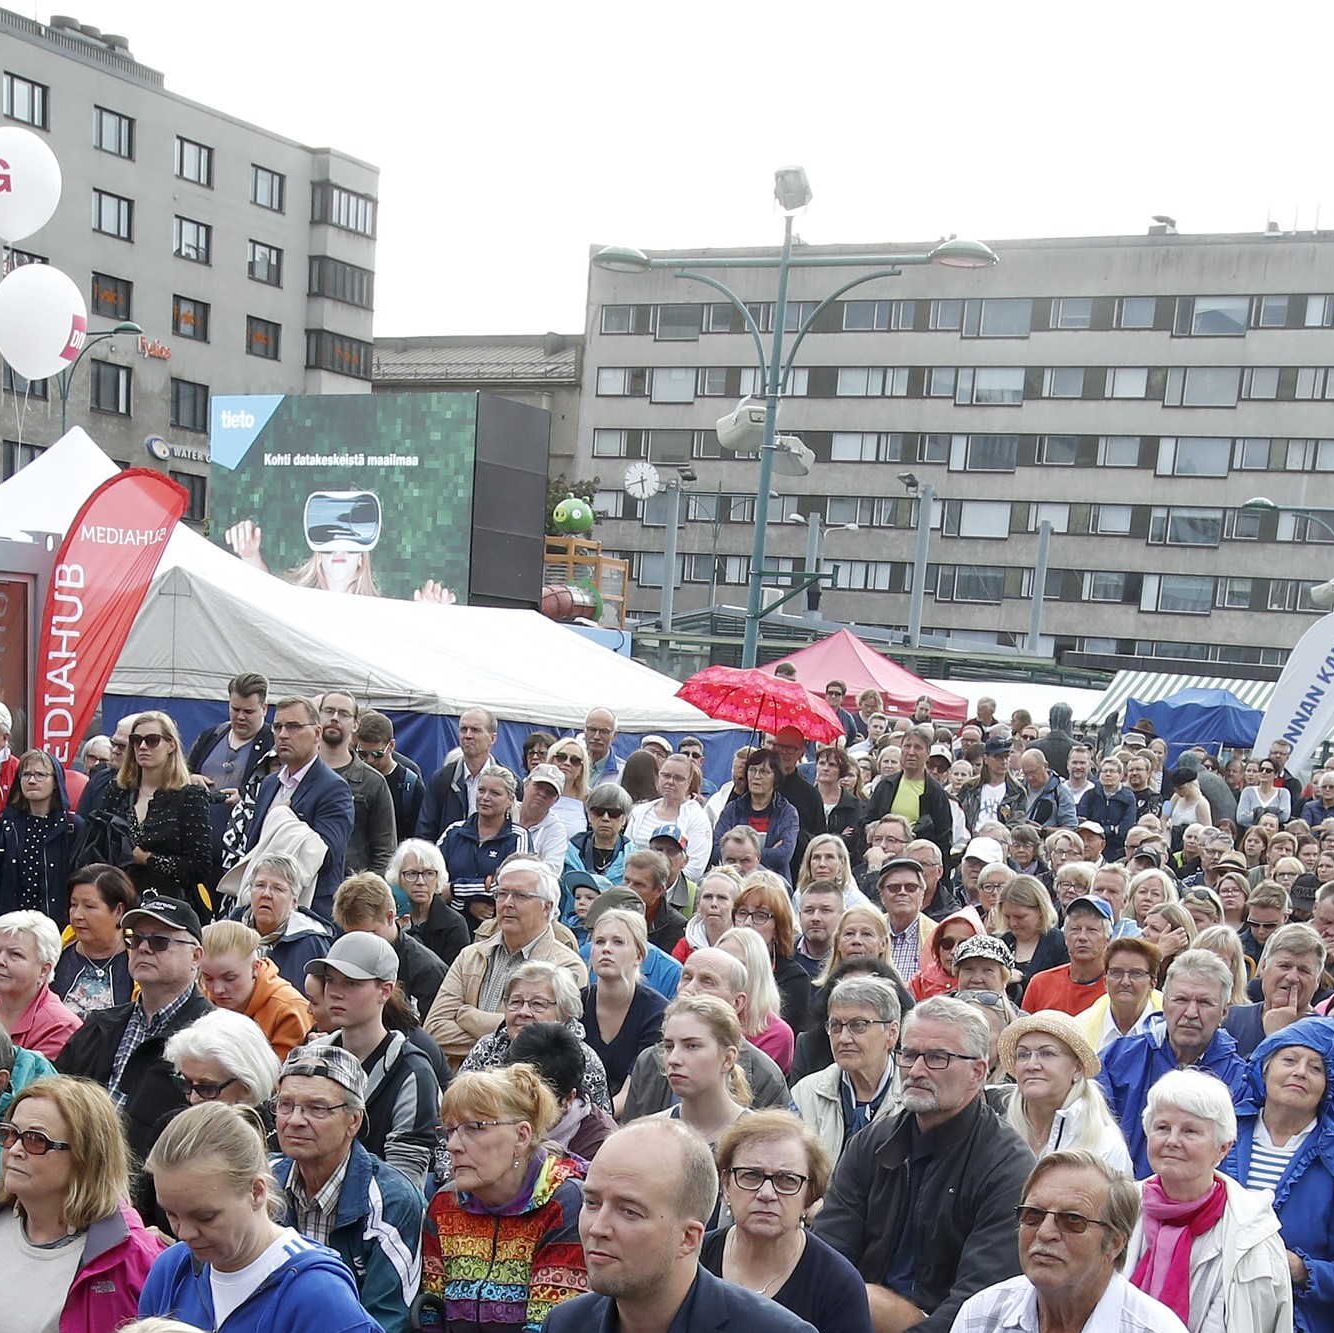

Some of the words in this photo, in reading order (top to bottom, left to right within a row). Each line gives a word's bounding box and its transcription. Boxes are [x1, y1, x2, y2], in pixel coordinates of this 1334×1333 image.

[69, 328, 86, 350] DN
[138, 335, 172, 361] Fysios
[221, 410, 255, 428] tieto
[173, 447, 204, 463] WATER
[263, 453, 292, 466] Kohti
[293, 453, 366, 466] datakeskeistä
[367, 453, 419, 466] maailmaa
[80, 525, 167, 546] MEDIAHUB
[43, 563, 85, 763] EDIAHUB
